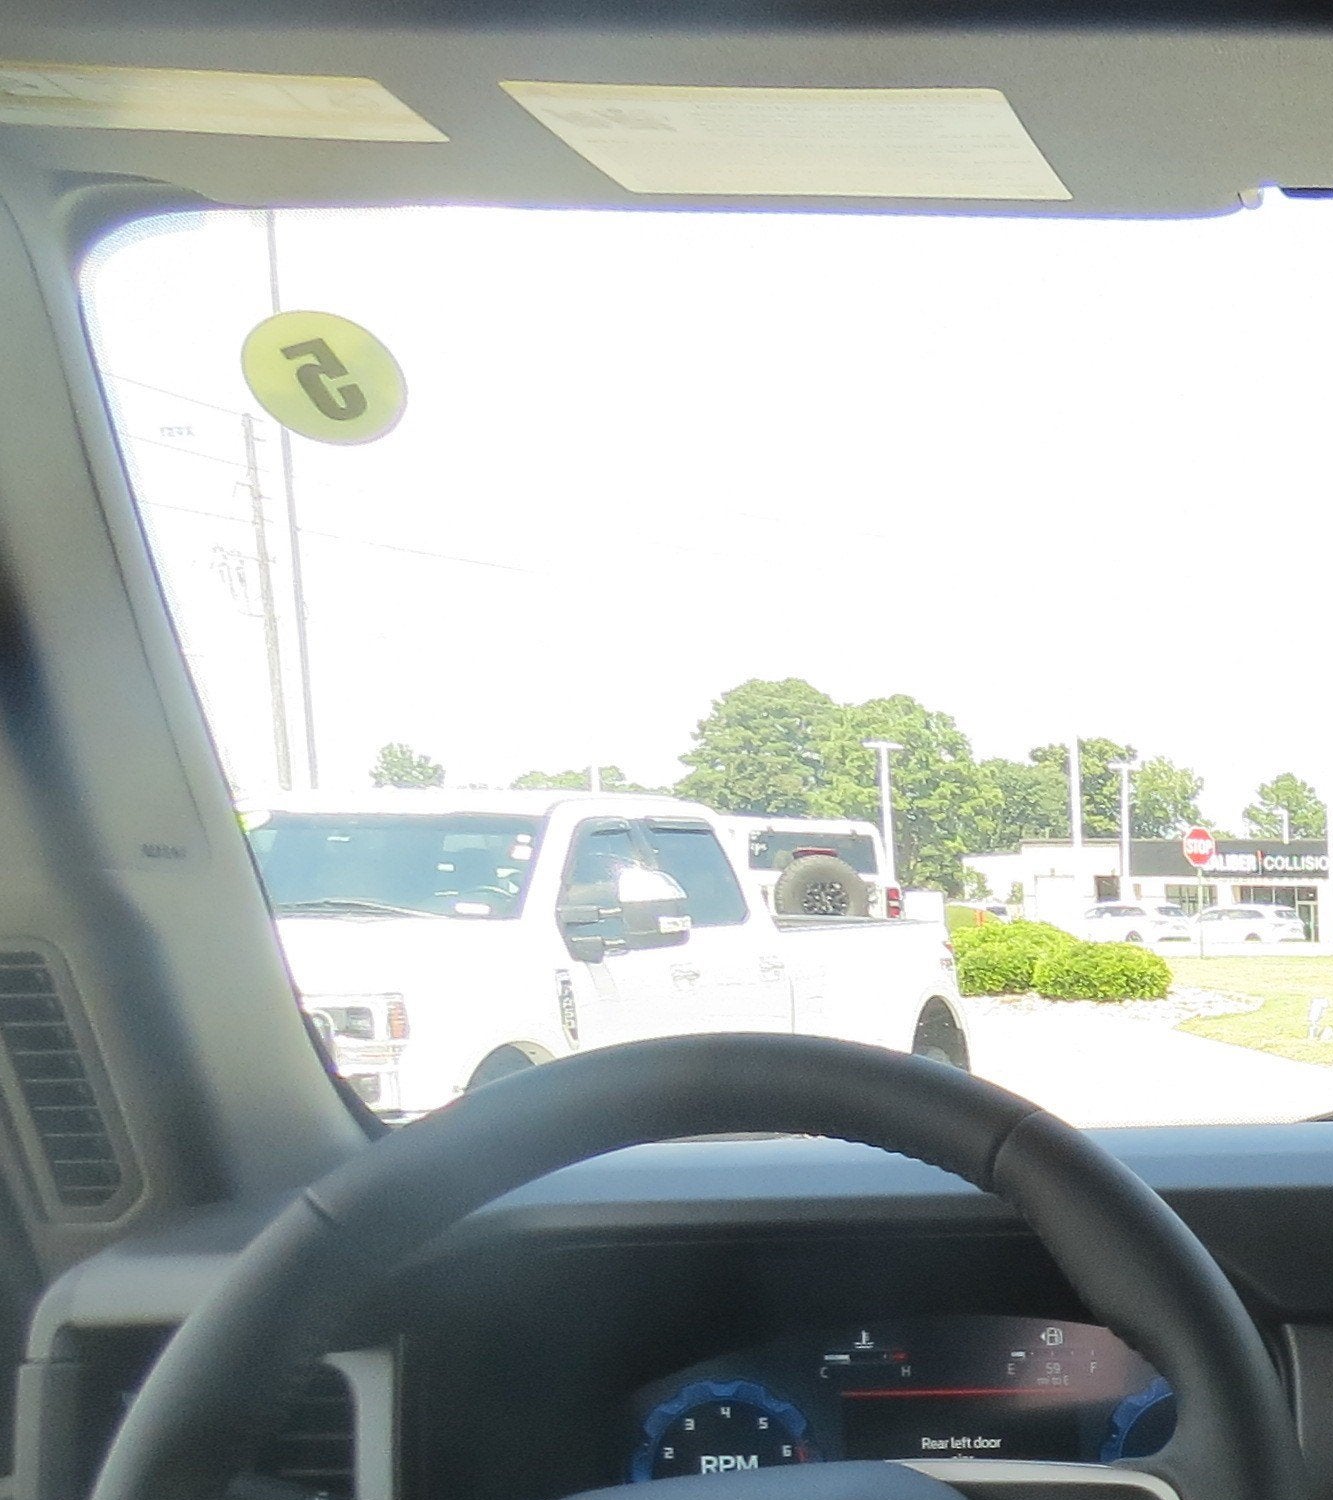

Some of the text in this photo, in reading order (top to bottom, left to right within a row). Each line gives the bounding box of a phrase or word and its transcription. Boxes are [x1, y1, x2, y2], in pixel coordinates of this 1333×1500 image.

[1185, 838, 1213, 855] STOP
[901, 1365, 911, 1377] H
[721, 1407, 731, 1418] 4
[685, 1418, 695, 1430] 3
[759, 1417, 768, 1429] 5
[922, 1436, 1002, 1450] Rear left door
[663, 1447, 674, 1459] 2
[782, 1445, 792, 1457] 6
[701, 1455, 759, 1474] RPM
